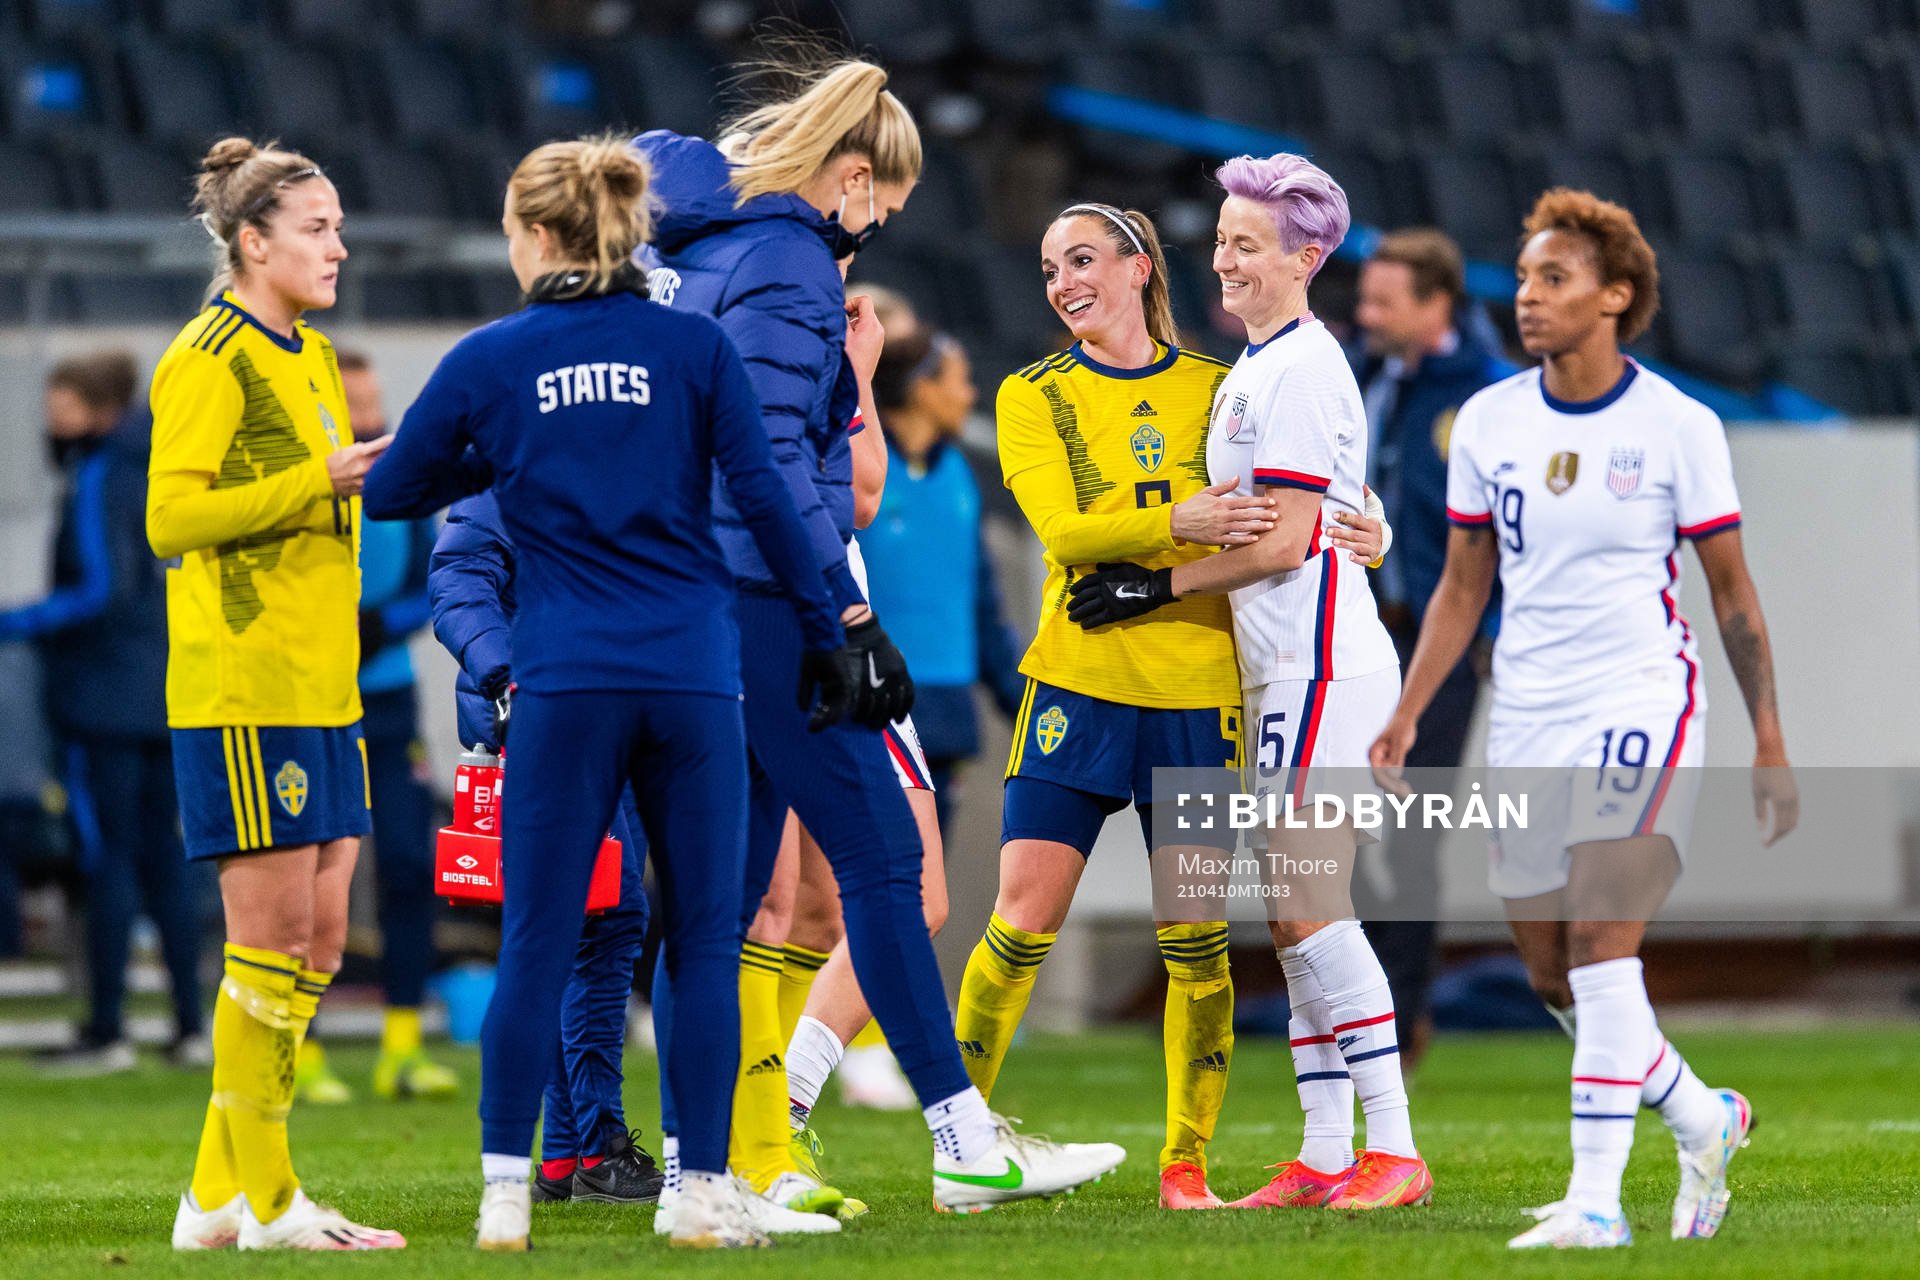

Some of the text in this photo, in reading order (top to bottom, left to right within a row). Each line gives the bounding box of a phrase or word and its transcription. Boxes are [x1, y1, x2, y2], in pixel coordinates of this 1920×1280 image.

[536, 362, 651, 414] STATES
[1220, 706, 1242, 773] 9
[1596, 729, 1651, 793] 19
[473, 804, 496, 814] STE
[442, 872, 493, 886] BIOSTEEL
